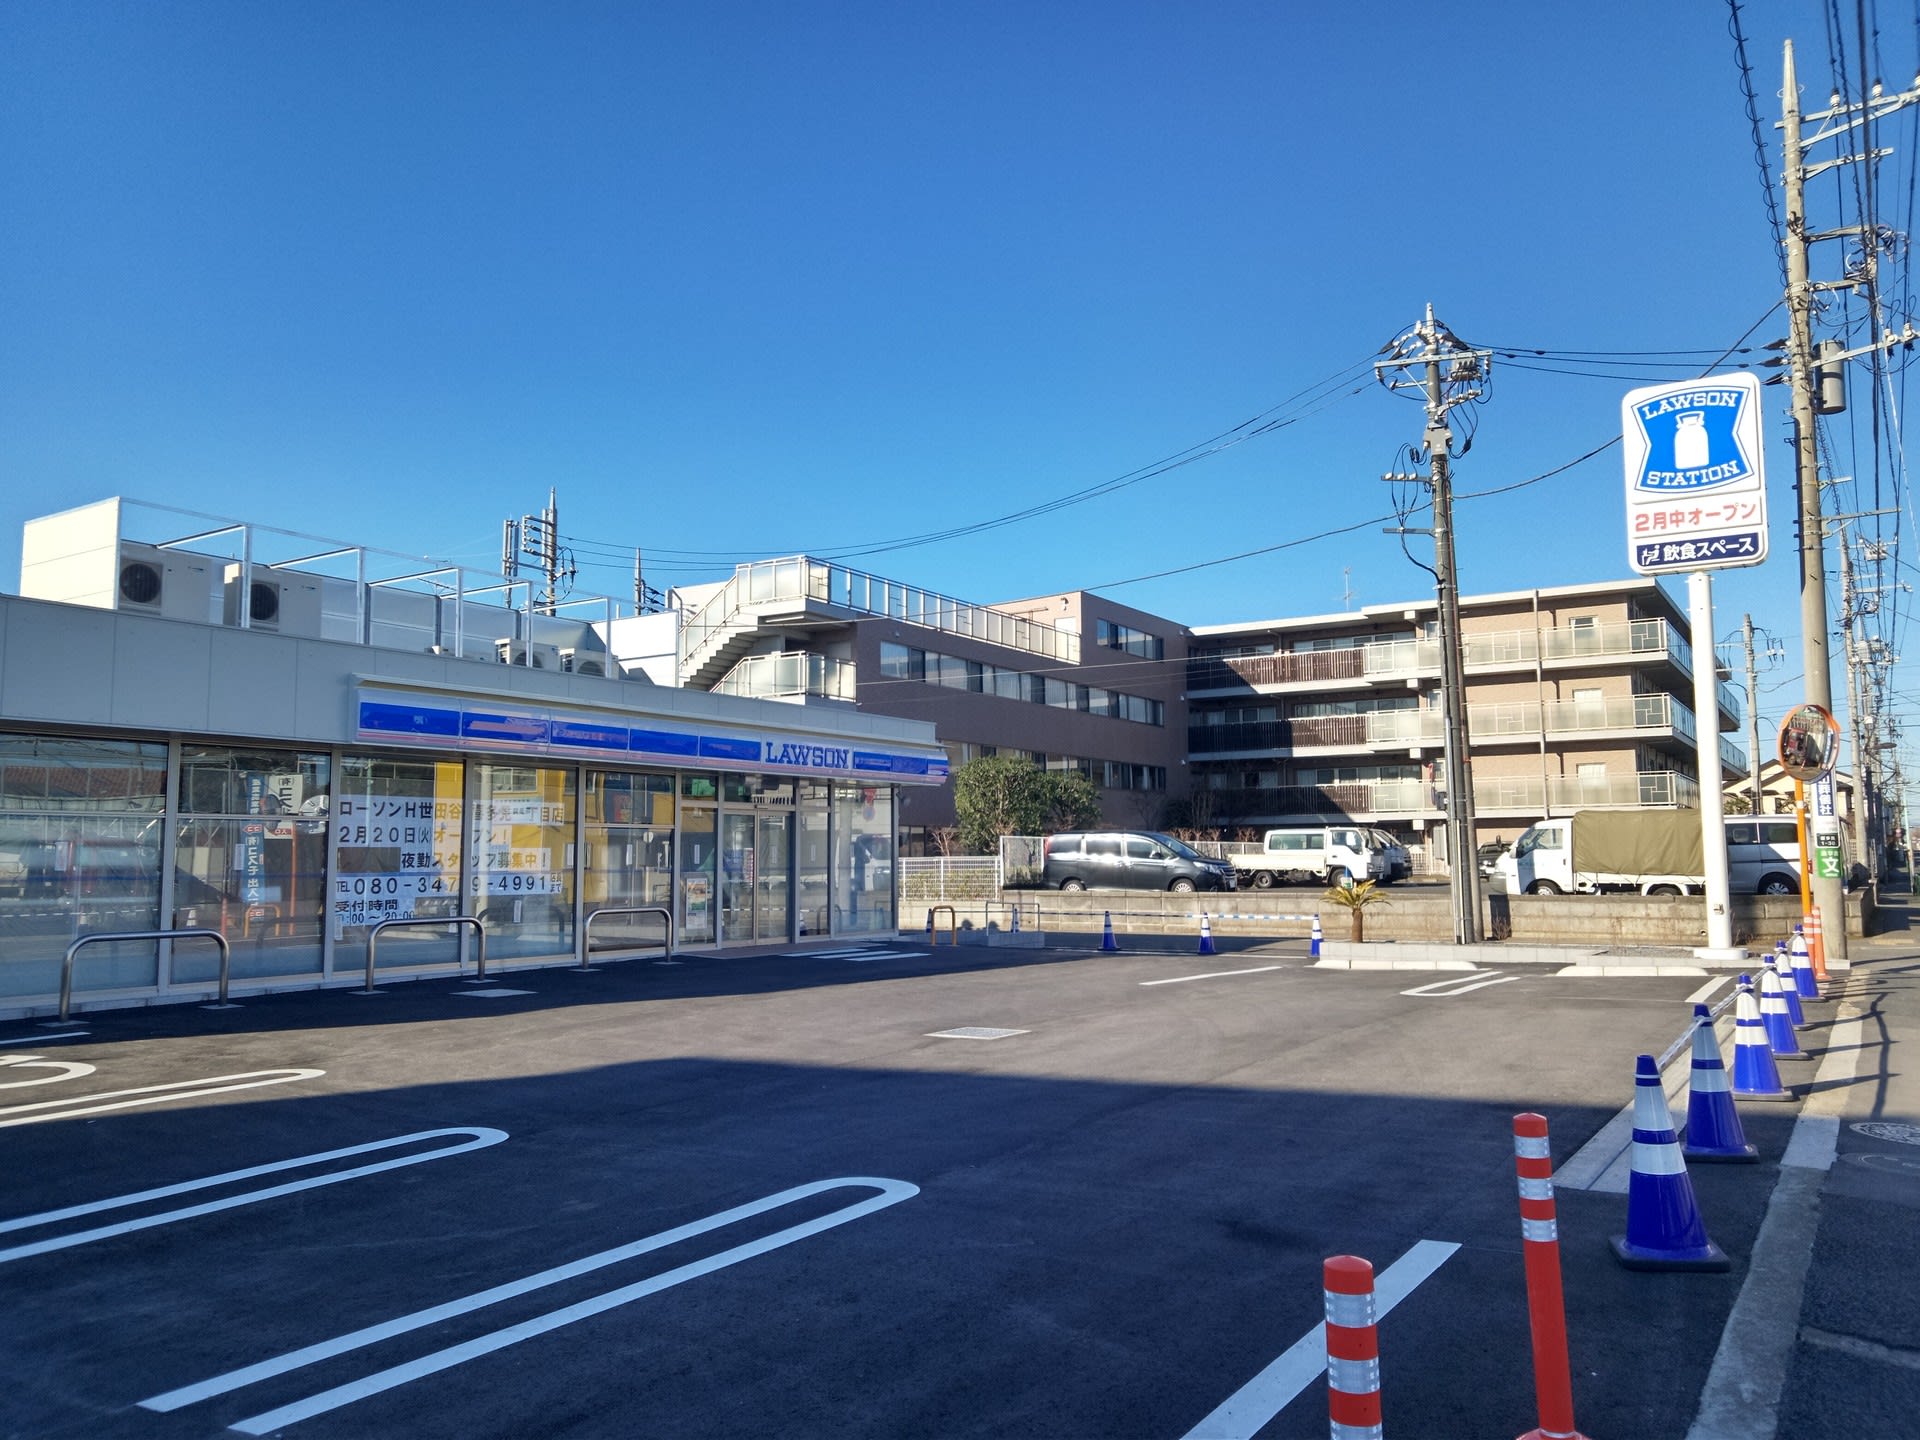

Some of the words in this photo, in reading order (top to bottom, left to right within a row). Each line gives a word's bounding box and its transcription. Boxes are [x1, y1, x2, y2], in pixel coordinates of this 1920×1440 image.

[1642, 391, 1739, 420] LAWSON
[1647, 460, 1740, 486] STATION
[1635, 503, 1757, 532] 2月中オープン
[1663, 537, 1755, 561] 飲食スペース
[765, 741, 850, 769] LAWSON
[335, 898, 399, 913] 受付時間
